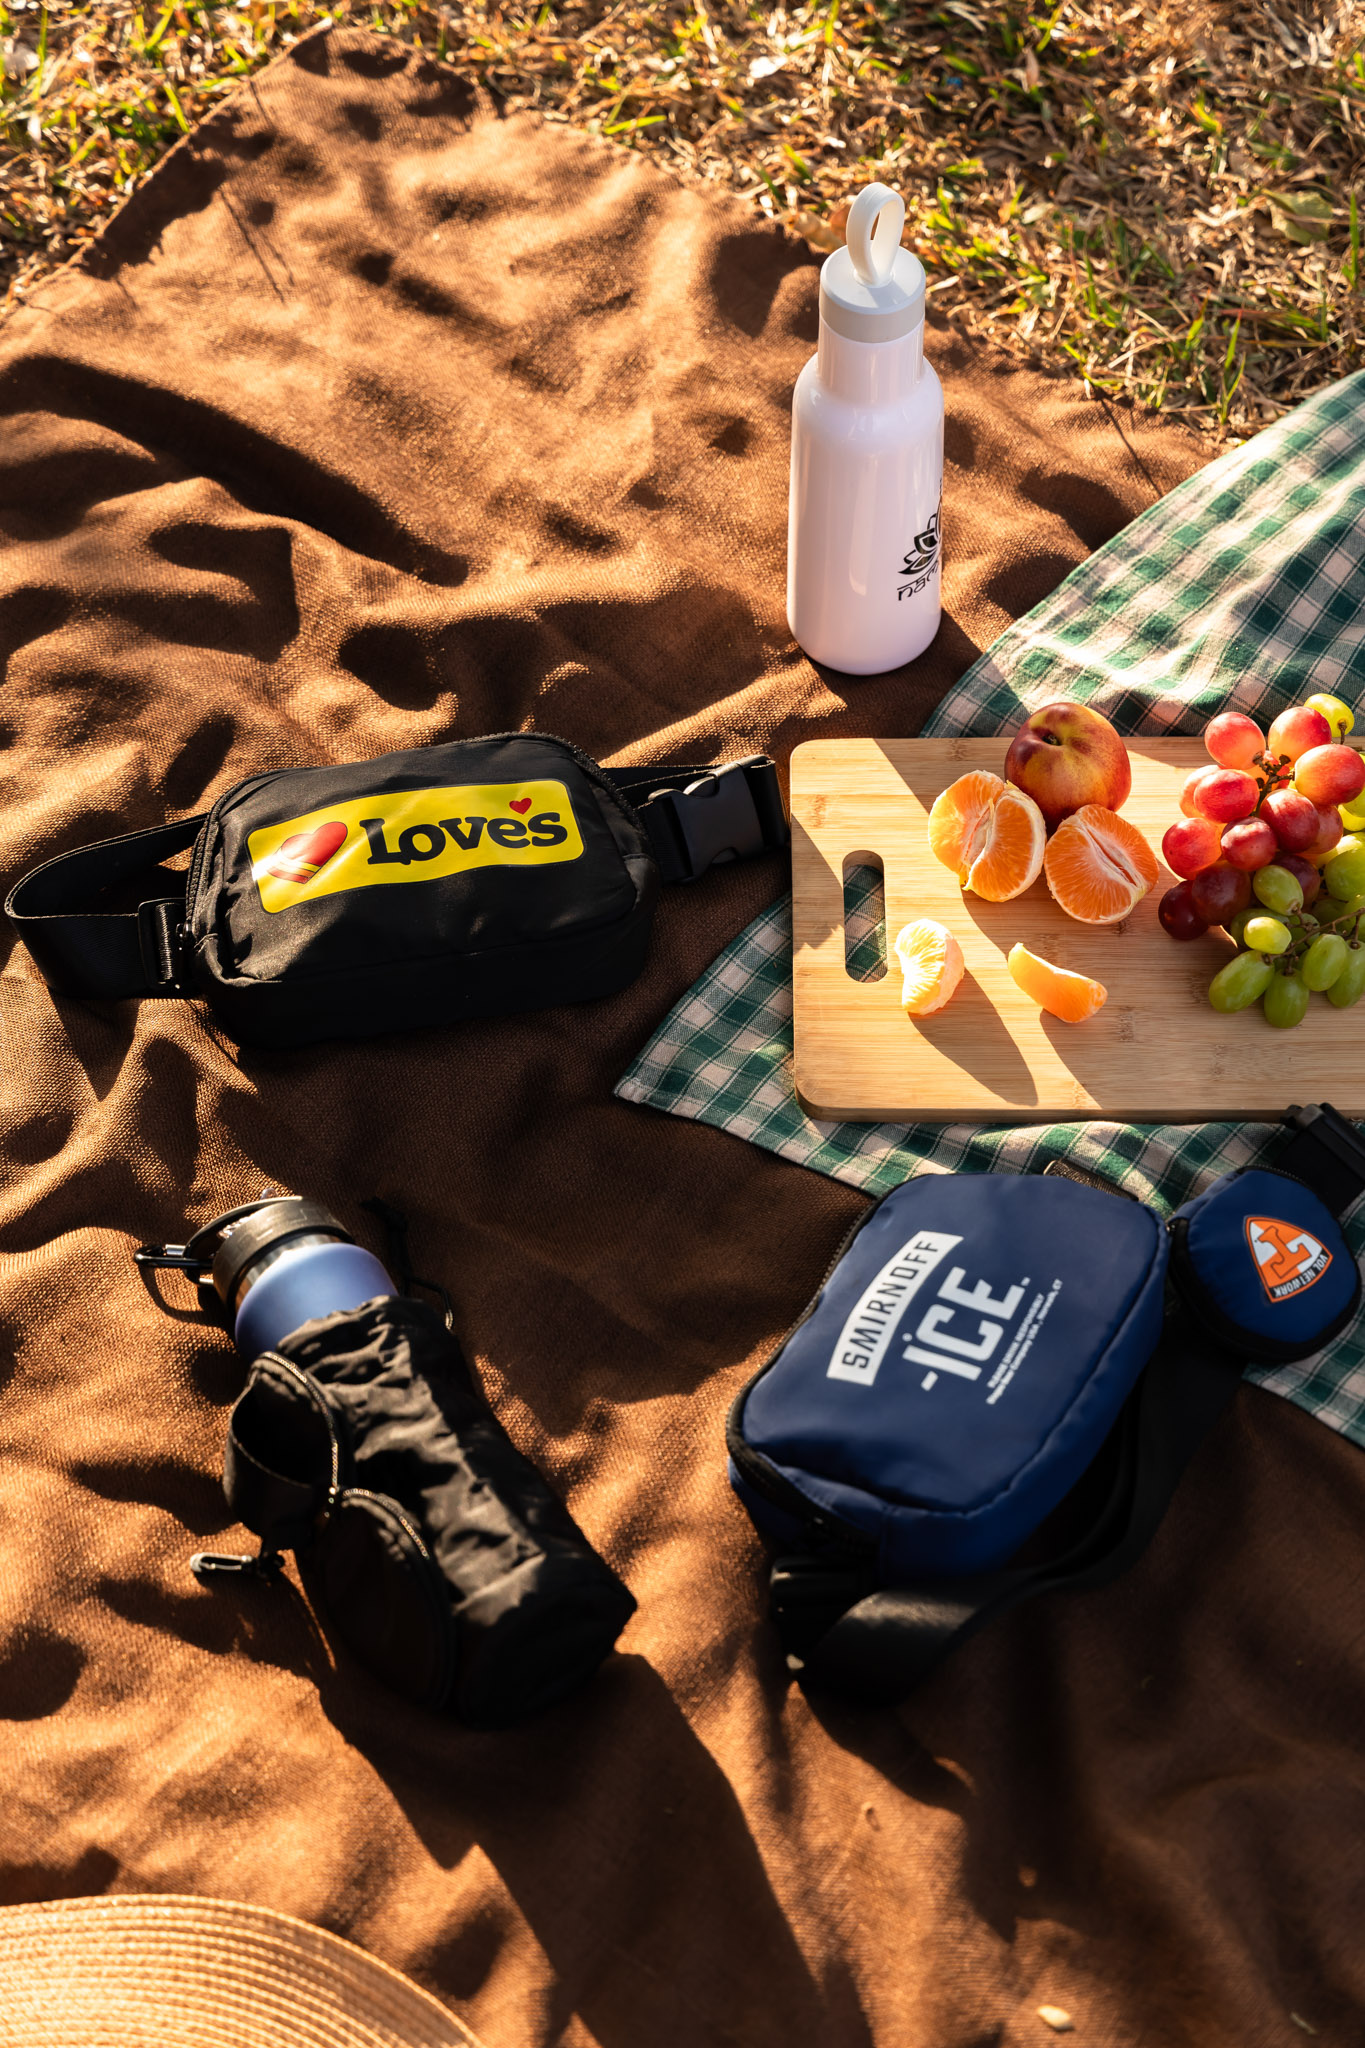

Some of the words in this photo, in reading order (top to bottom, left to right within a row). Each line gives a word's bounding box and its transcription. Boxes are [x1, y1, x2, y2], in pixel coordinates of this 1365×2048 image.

[1313, 1253, 1329, 1271] VOL
[1273, 1270, 1316, 1298] NETWORK
[842, 1240, 938, 1368] SMIRNOFF
